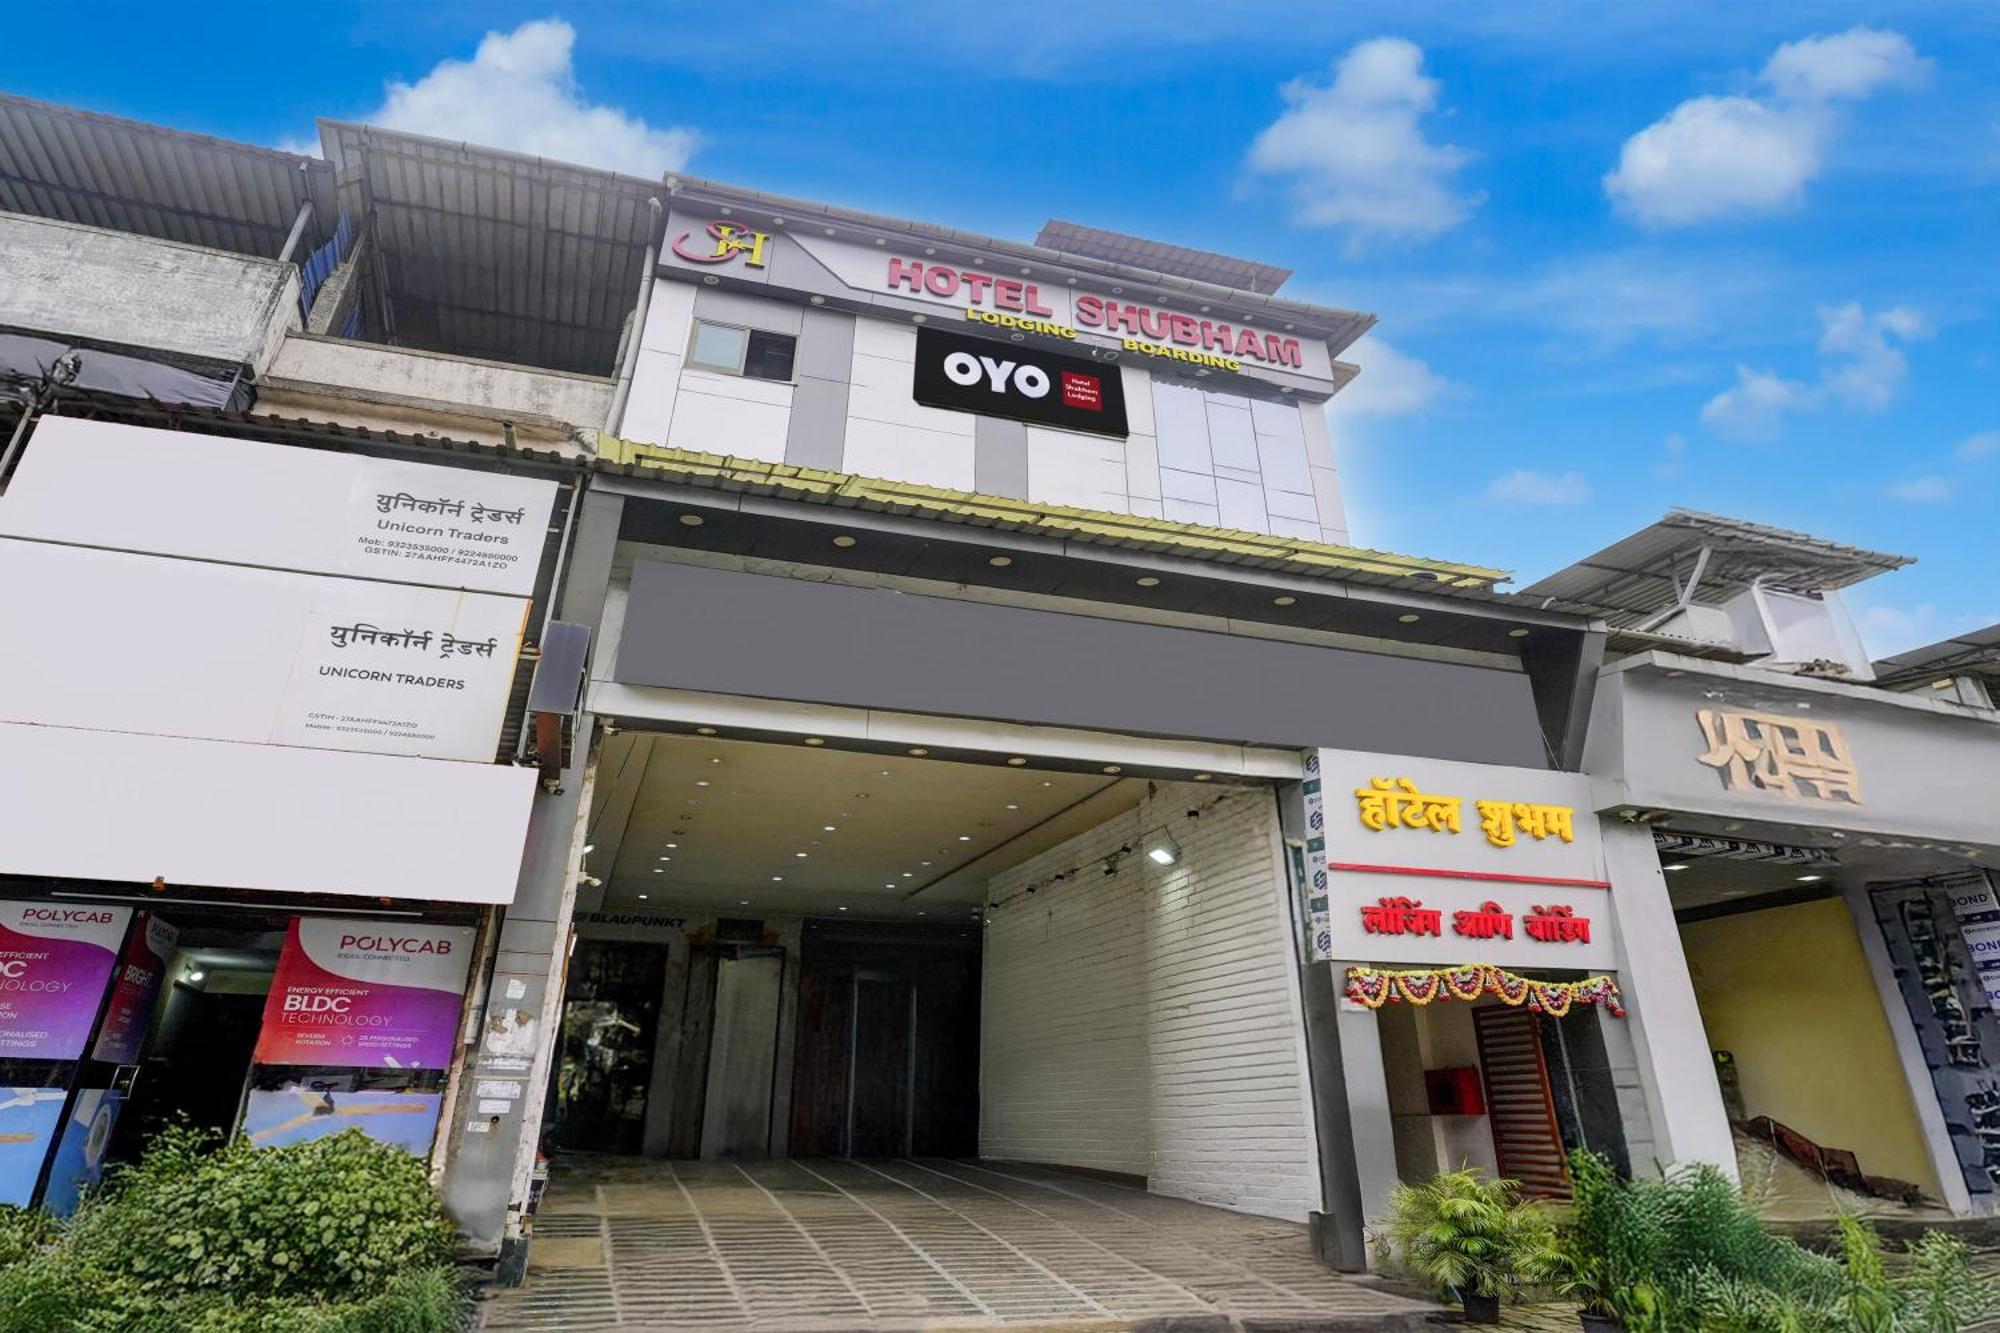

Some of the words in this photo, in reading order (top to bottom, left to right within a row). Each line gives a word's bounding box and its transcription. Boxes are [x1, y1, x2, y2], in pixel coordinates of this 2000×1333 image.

[888, 257, 1053, 317] HOTEL
[1076, 295, 1302, 367] SHUBHAM
[966, 308, 1079, 340] LODGING
[1122, 338, 1242, 373] BOARDING
[944, 351, 1050, 398] OYO
[376, 492, 464, 517] युनिकॉर्न
[471, 503, 525, 525] ट्रेडर्स
[377, 519, 444, 537] Unicorn
[449, 529, 510, 544] Traders
[331, 623, 433, 651] युनिकॉर्न
[439, 632, 498, 659] ट्रेडर्स
[319, 665, 392, 682] UNICORN
[396, 673, 465, 690] TRADERS
[1356, 776, 1462, 833] हॉटेल
[1476, 800, 1575, 848] शुभम
[22, 908, 114, 924] POLYCAB
[589, 912, 688, 929] BLAUPUNKT
[340, 935, 452, 955] POLYCAB
[284, 995, 352, 1012] BLDC
[287, 986, 323, 995] ENERGY
[325, 987, 370, 997] EFFICIENT
[280, 1012, 393, 1027] TECHNOLOGY
